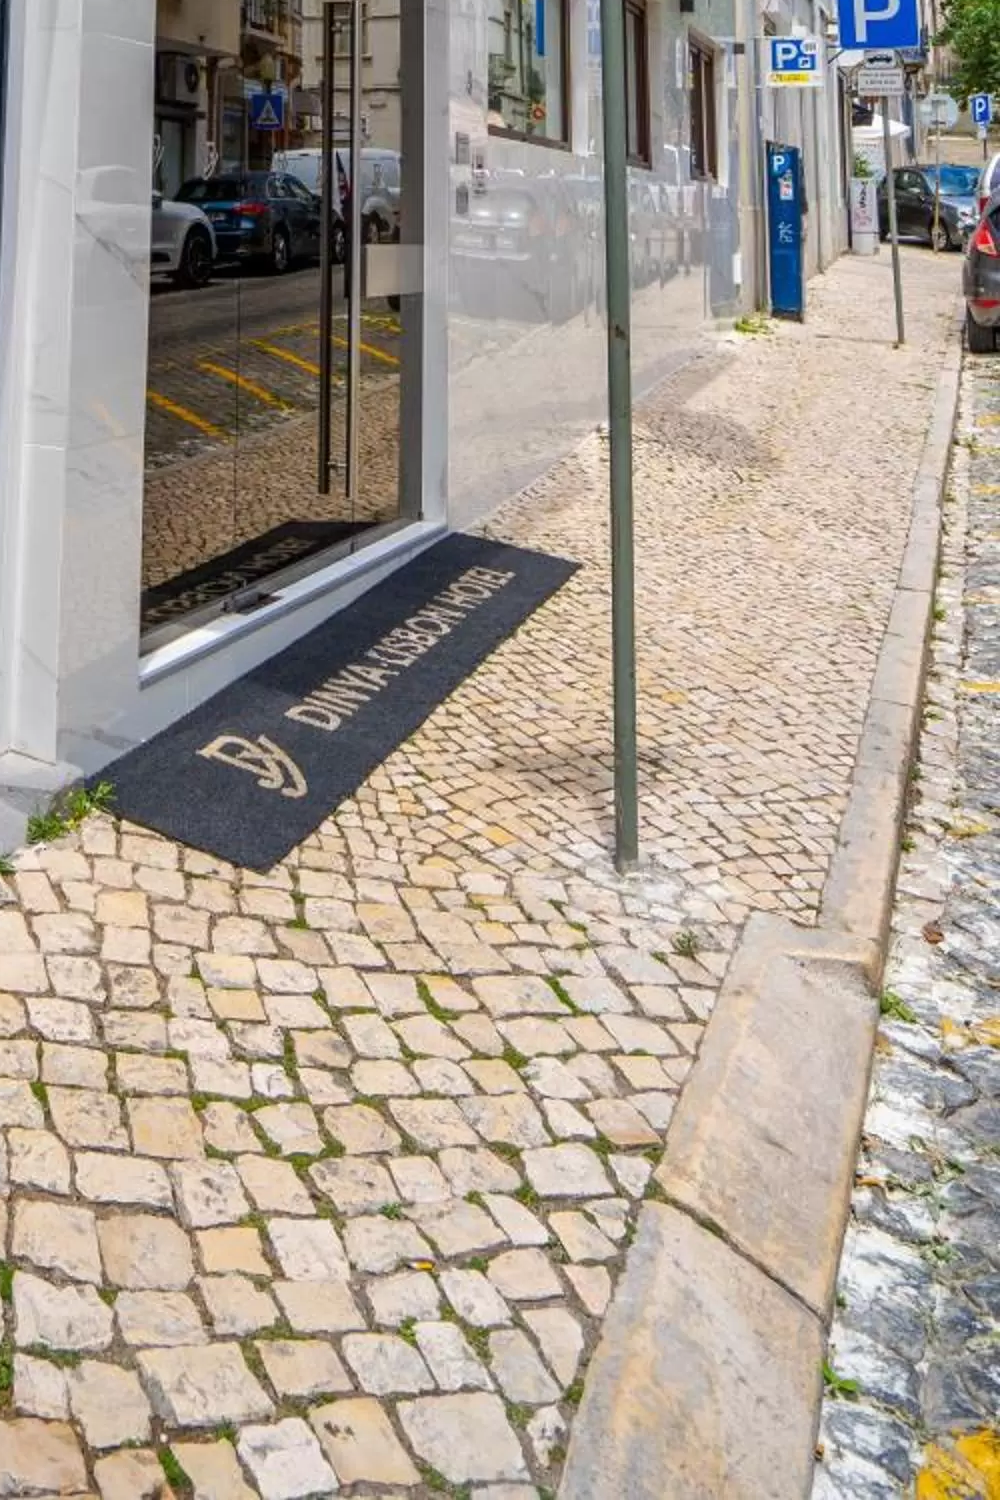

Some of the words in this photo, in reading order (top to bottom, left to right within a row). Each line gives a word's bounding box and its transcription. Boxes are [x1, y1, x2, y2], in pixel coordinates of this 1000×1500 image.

[775, 42, 798, 69] P
[284, 663, 400, 731] DINYA
[365, 603, 467, 667] LISBON
[434, 566, 516, 609] HOTEL
